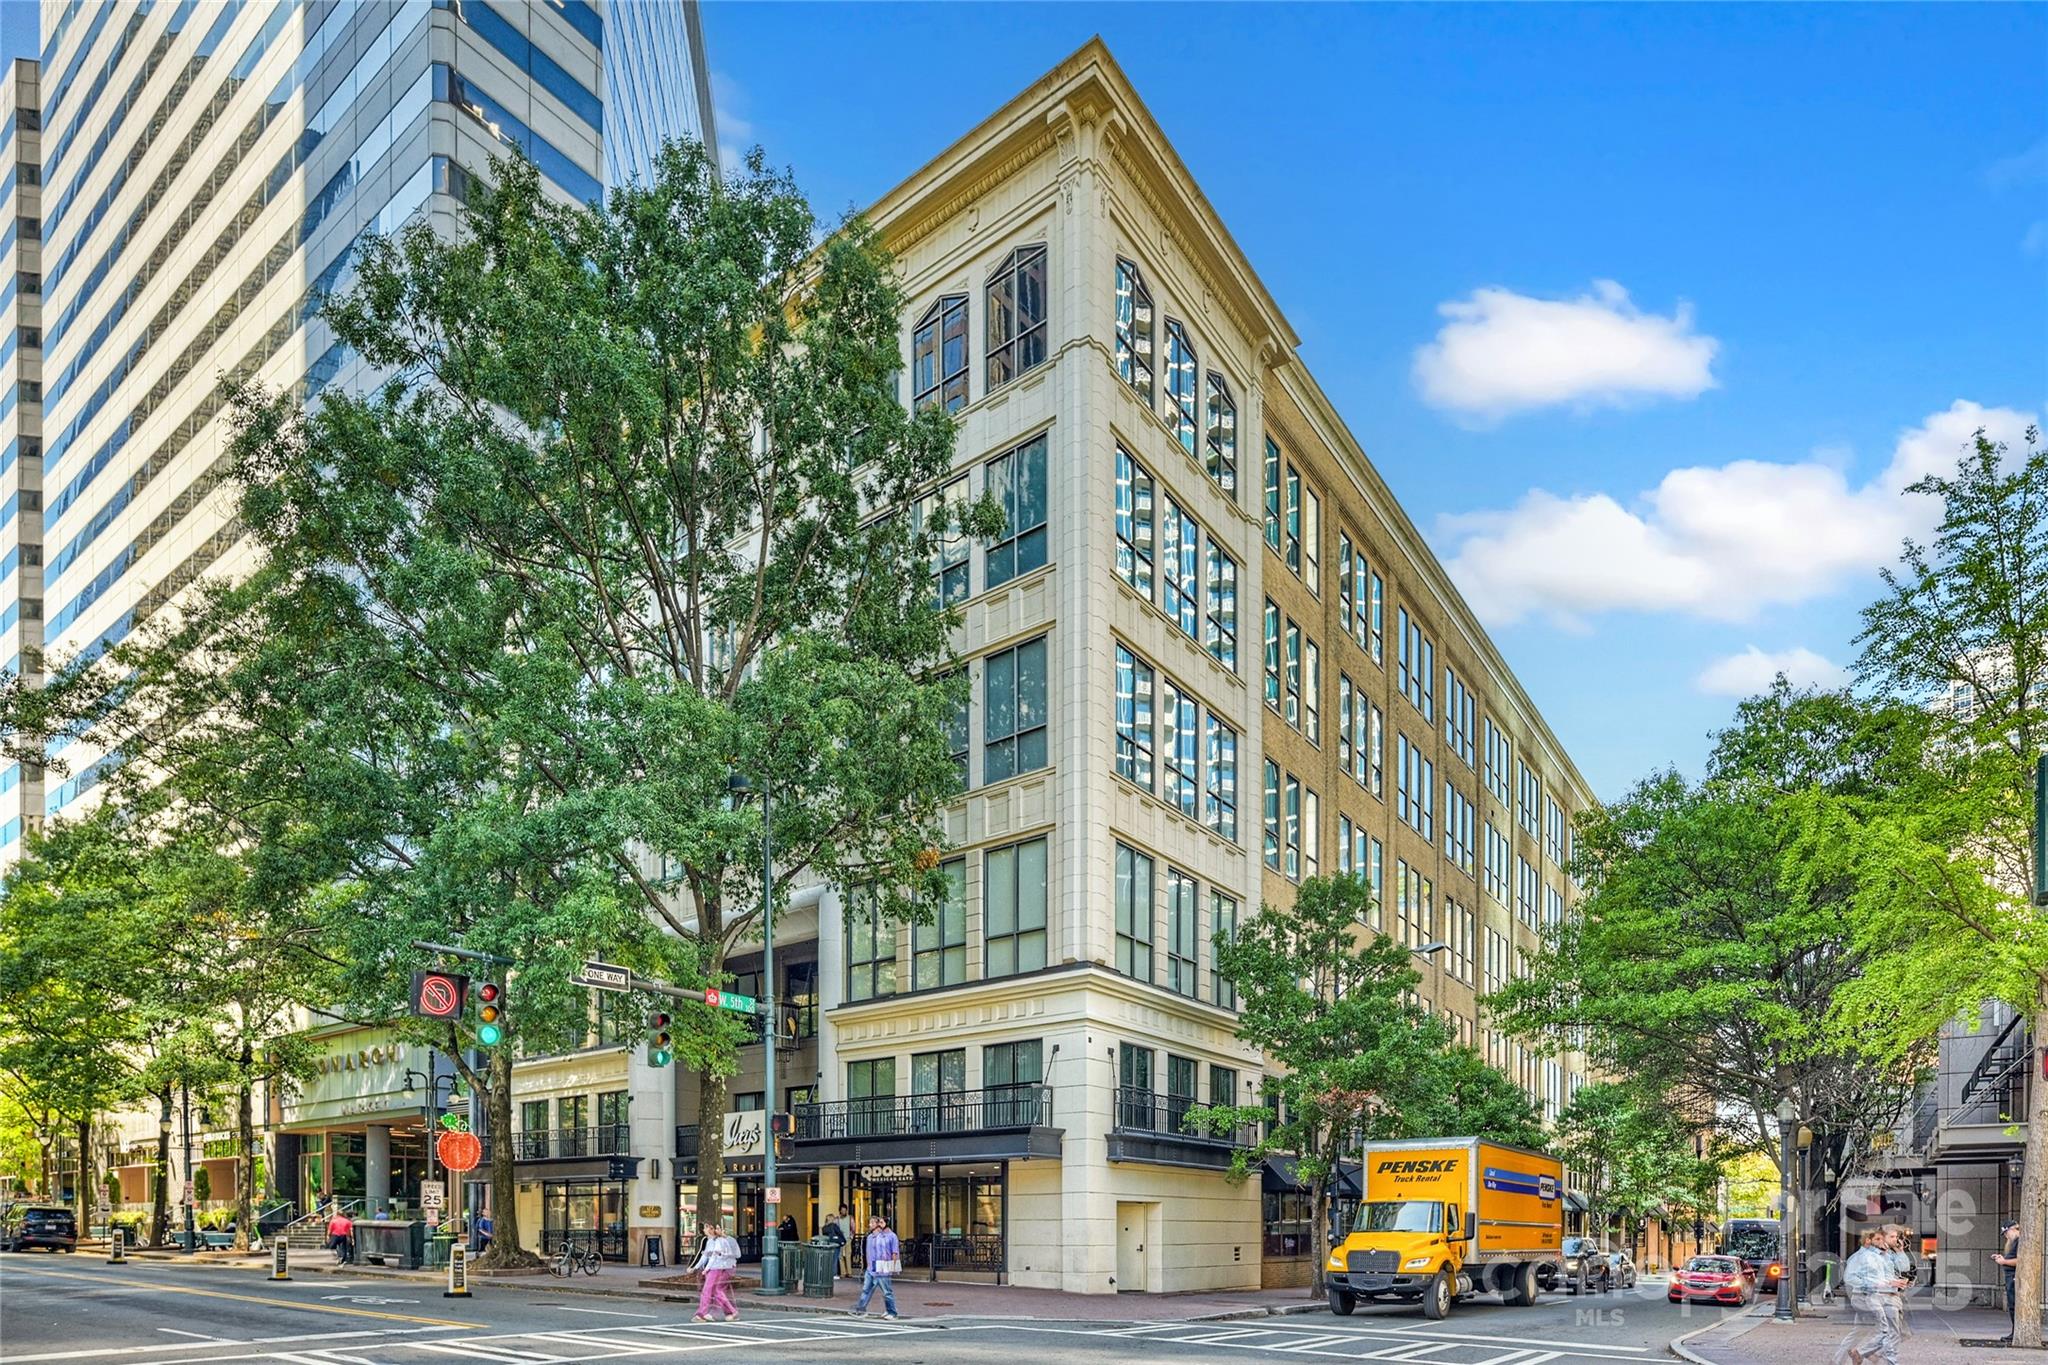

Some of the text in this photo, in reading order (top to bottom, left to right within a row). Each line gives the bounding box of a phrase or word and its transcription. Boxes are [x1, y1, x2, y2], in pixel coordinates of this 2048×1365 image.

[587, 970, 623, 983] ONE WAY
[730, 996, 743, 1009] 5th
[861, 1165, 914, 1181] QDOBA
[1377, 1160, 1459, 1174] PENSKE
[1394, 1174, 1442, 1183] Truck Rental
[423, 1195, 442, 1204] 25
